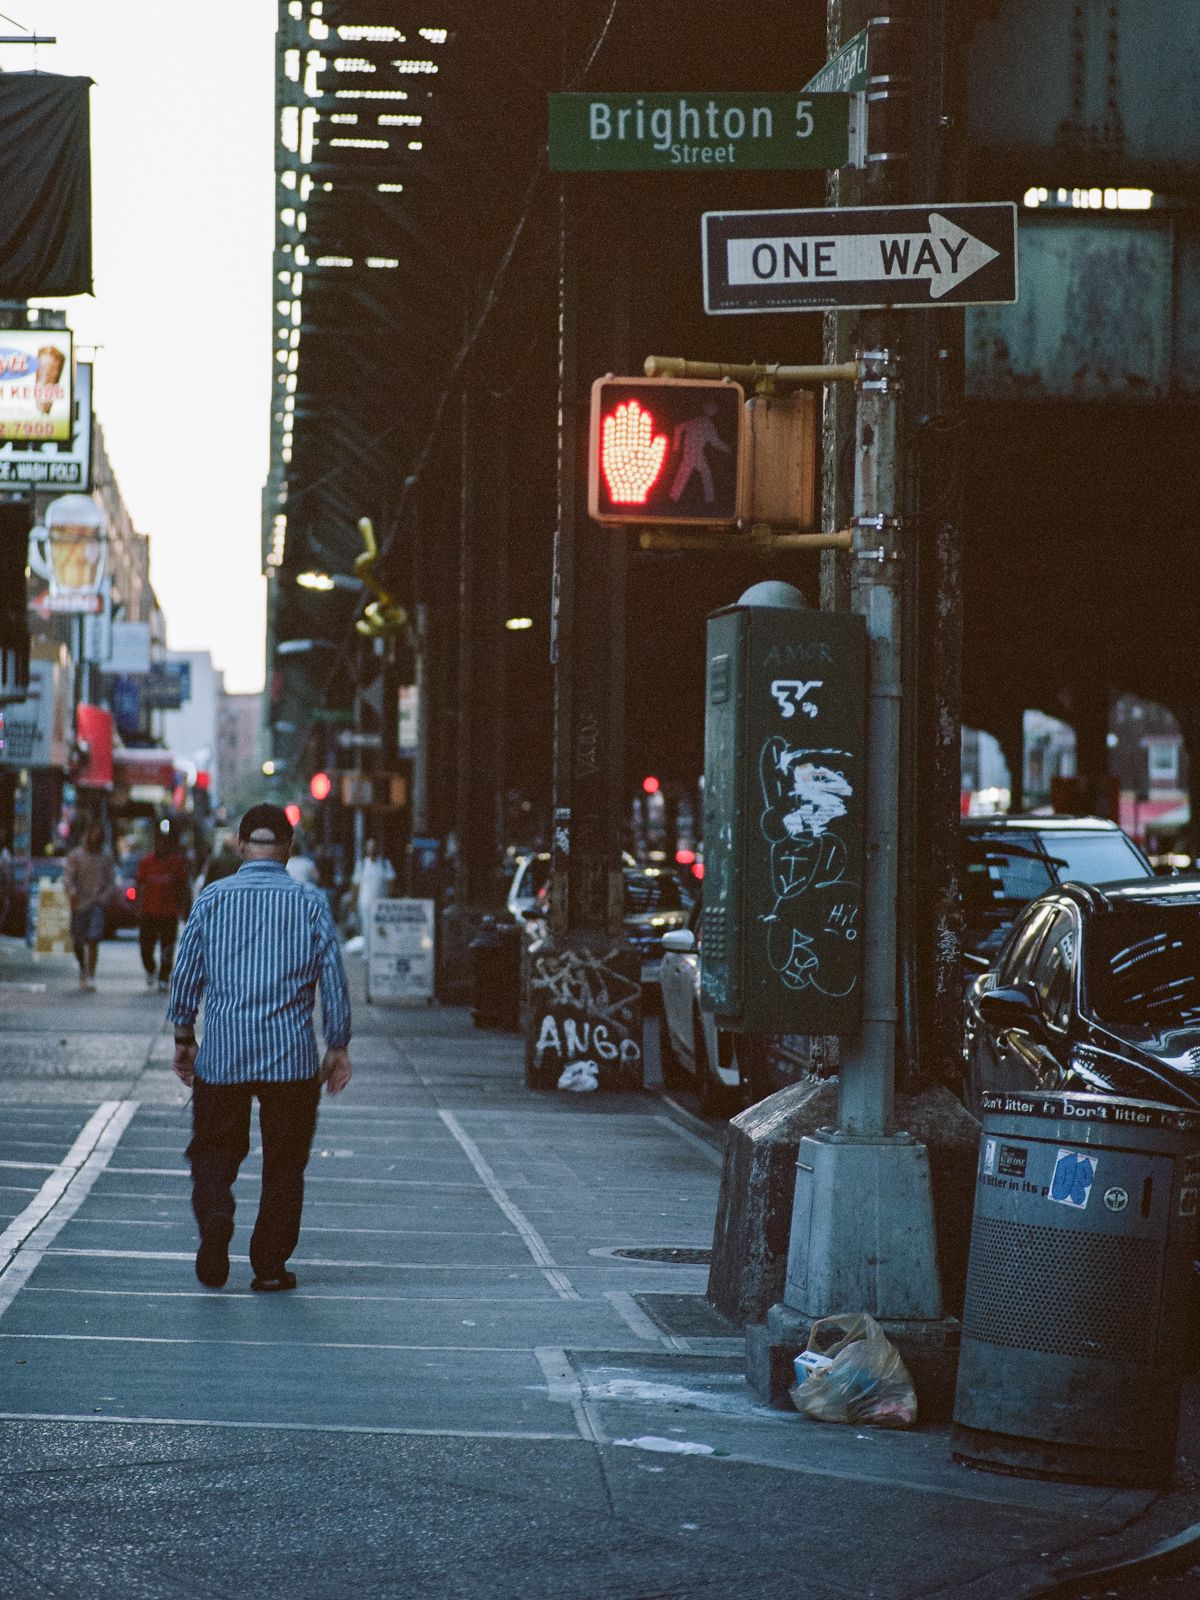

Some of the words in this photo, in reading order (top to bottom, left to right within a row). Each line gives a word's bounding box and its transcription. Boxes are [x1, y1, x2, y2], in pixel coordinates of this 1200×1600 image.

[590, 99, 773, 150] Brighton
[796, 101, 814, 138] 5
[670, 143, 737, 164] Street
[752, 241, 838, 279] ONE
[879, 237, 969, 276] WAY
[1004, 1098, 1035, 1113] litter
[1063, 1098, 1108, 1119] Don't
[1115, 1107, 1153, 1124] litter
